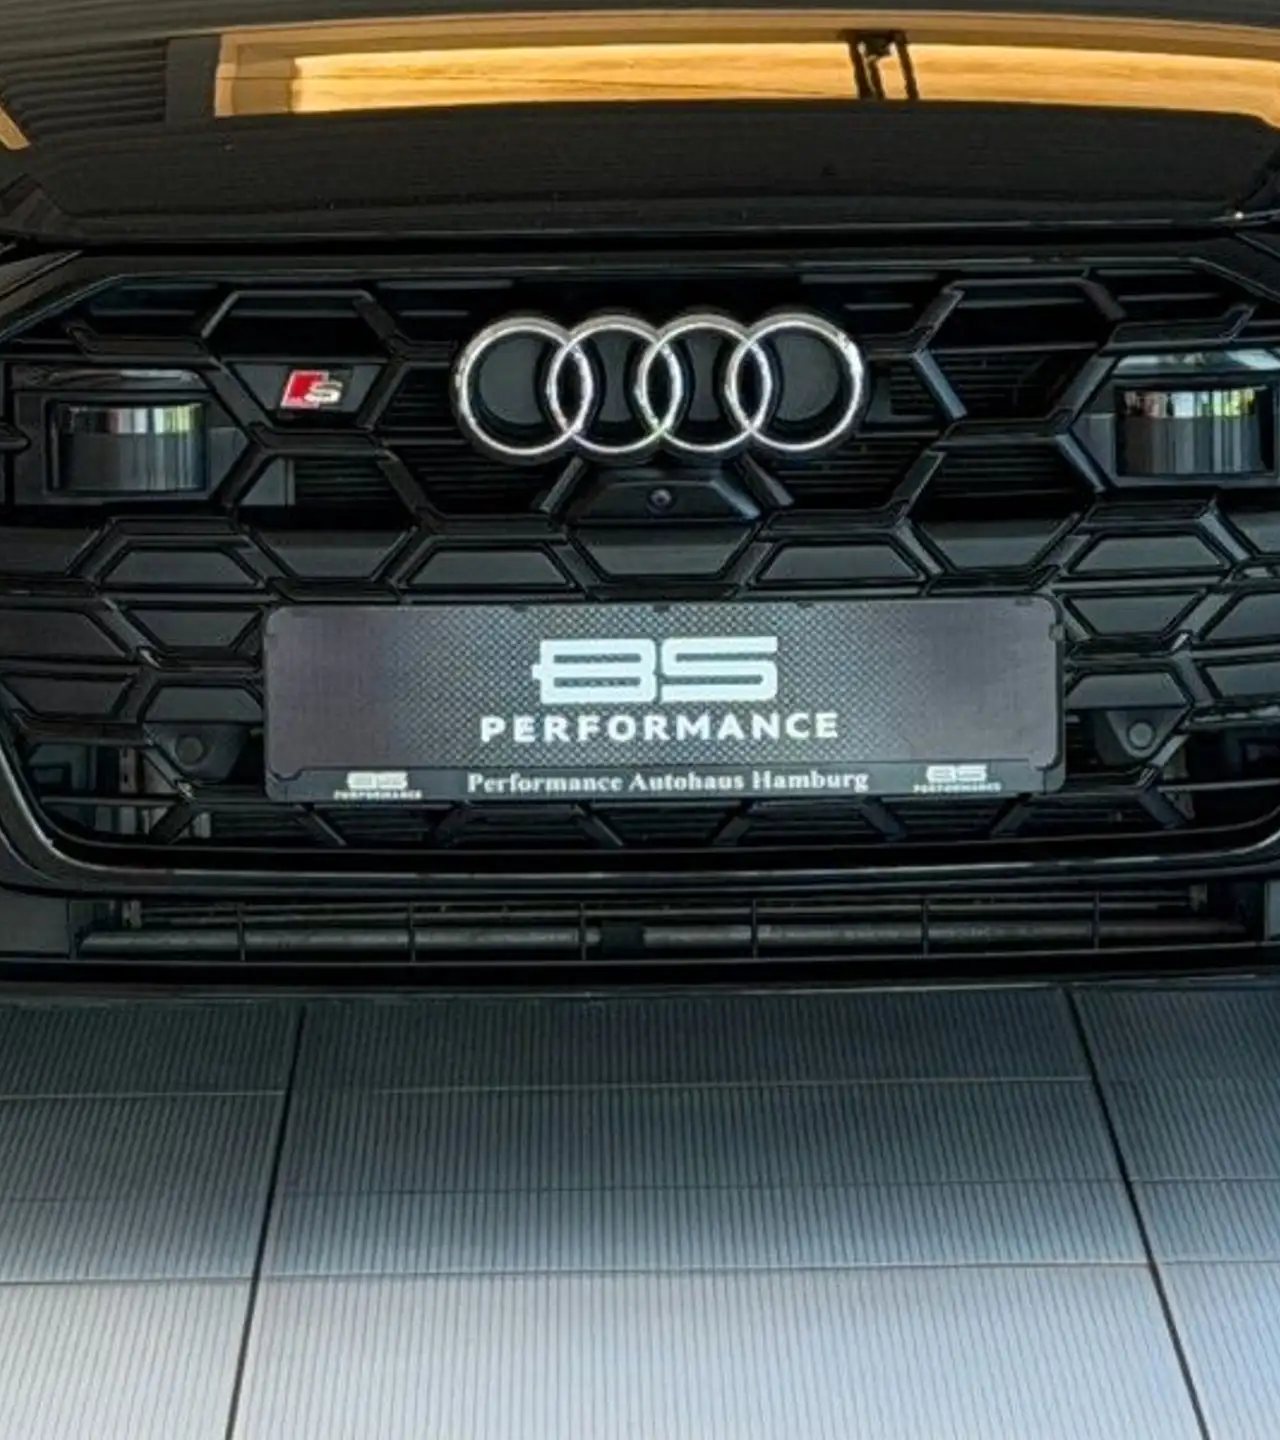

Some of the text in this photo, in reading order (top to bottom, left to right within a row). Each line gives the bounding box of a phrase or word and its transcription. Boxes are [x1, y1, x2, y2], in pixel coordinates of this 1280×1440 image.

[480, 712, 839, 743] PERFORMANCE
[467, 770, 870, 793] Performance Autohaus Hamburg
